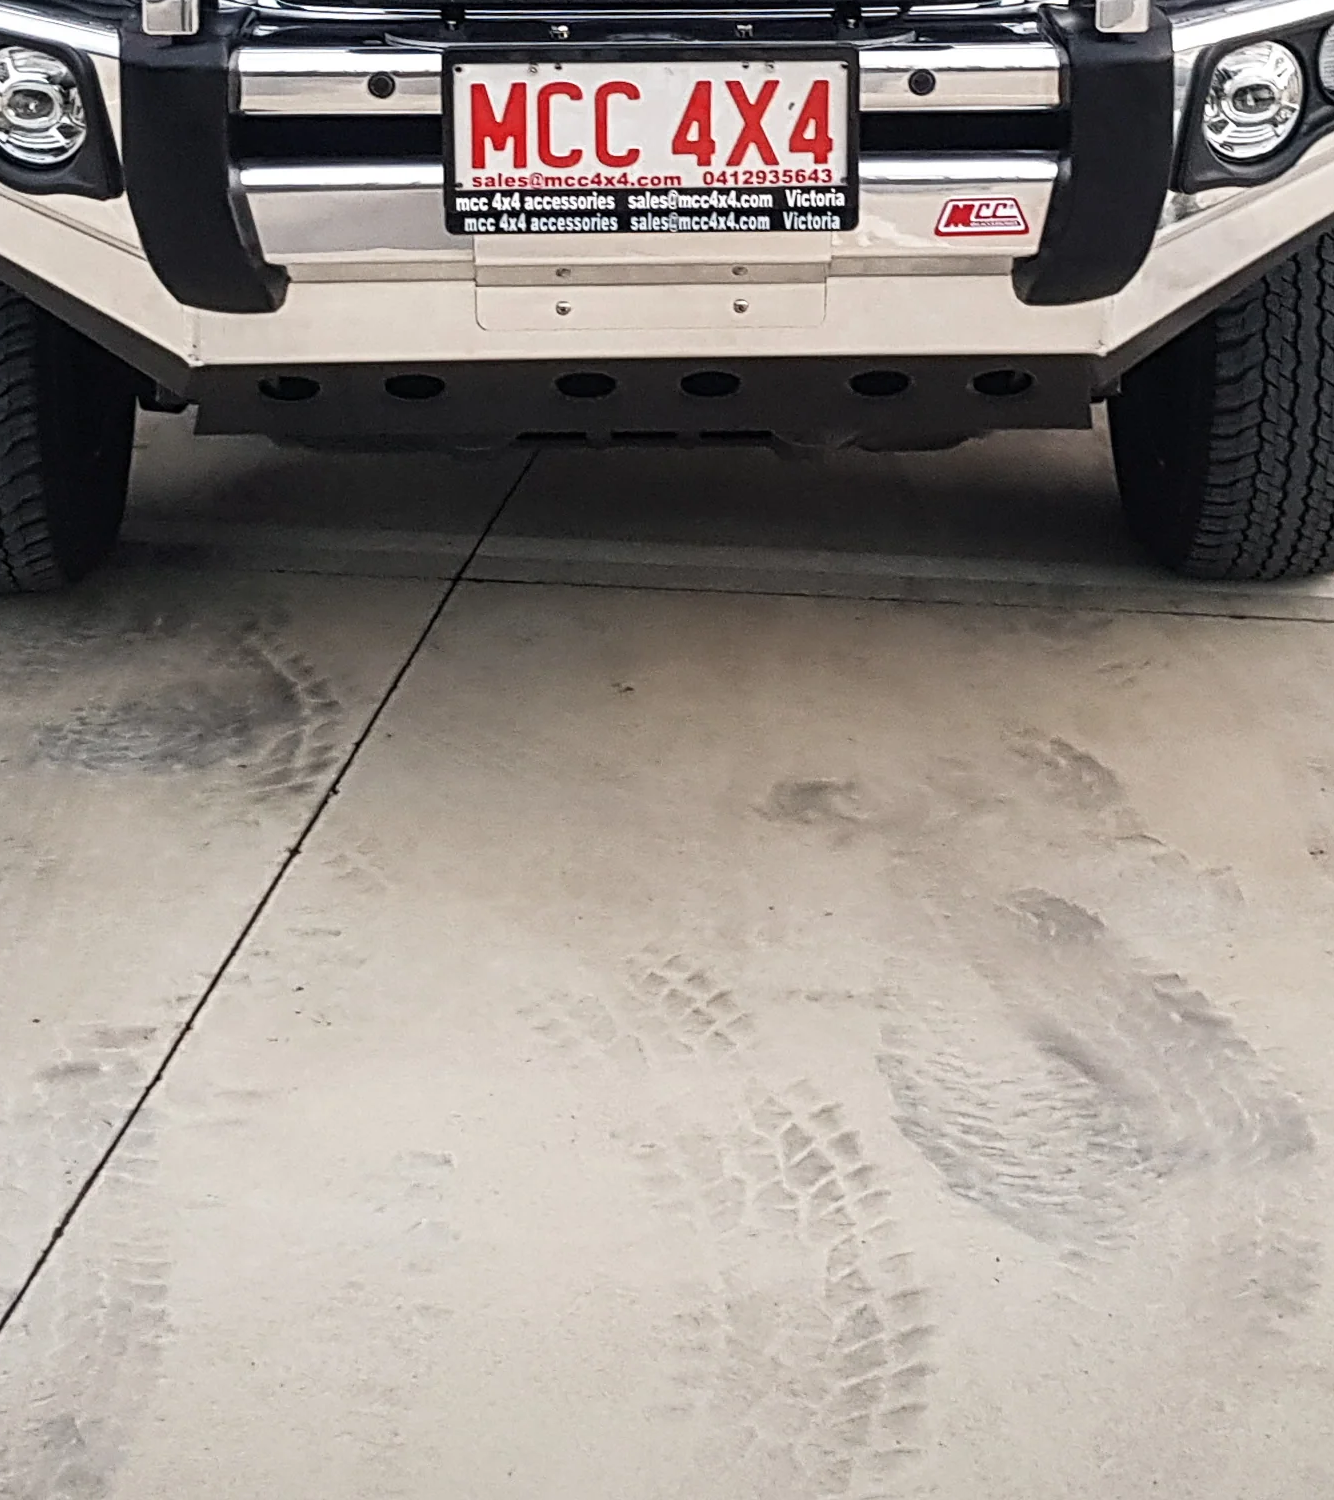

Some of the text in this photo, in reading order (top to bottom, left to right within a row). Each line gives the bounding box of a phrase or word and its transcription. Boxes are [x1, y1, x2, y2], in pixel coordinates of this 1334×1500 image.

[470, 79, 834, 169] MCC 4X4
[471, 168, 833, 189] sales@mcc4x4.com 0412935643
[455, 188, 846, 212] mcc 4x4 accessories sales@mcc4x4.com Victoria
[463, 211, 842, 232] mcc 4x4 accessories sales@mcc4x4.com Victoria
[944, 202, 1018, 227] MCC
